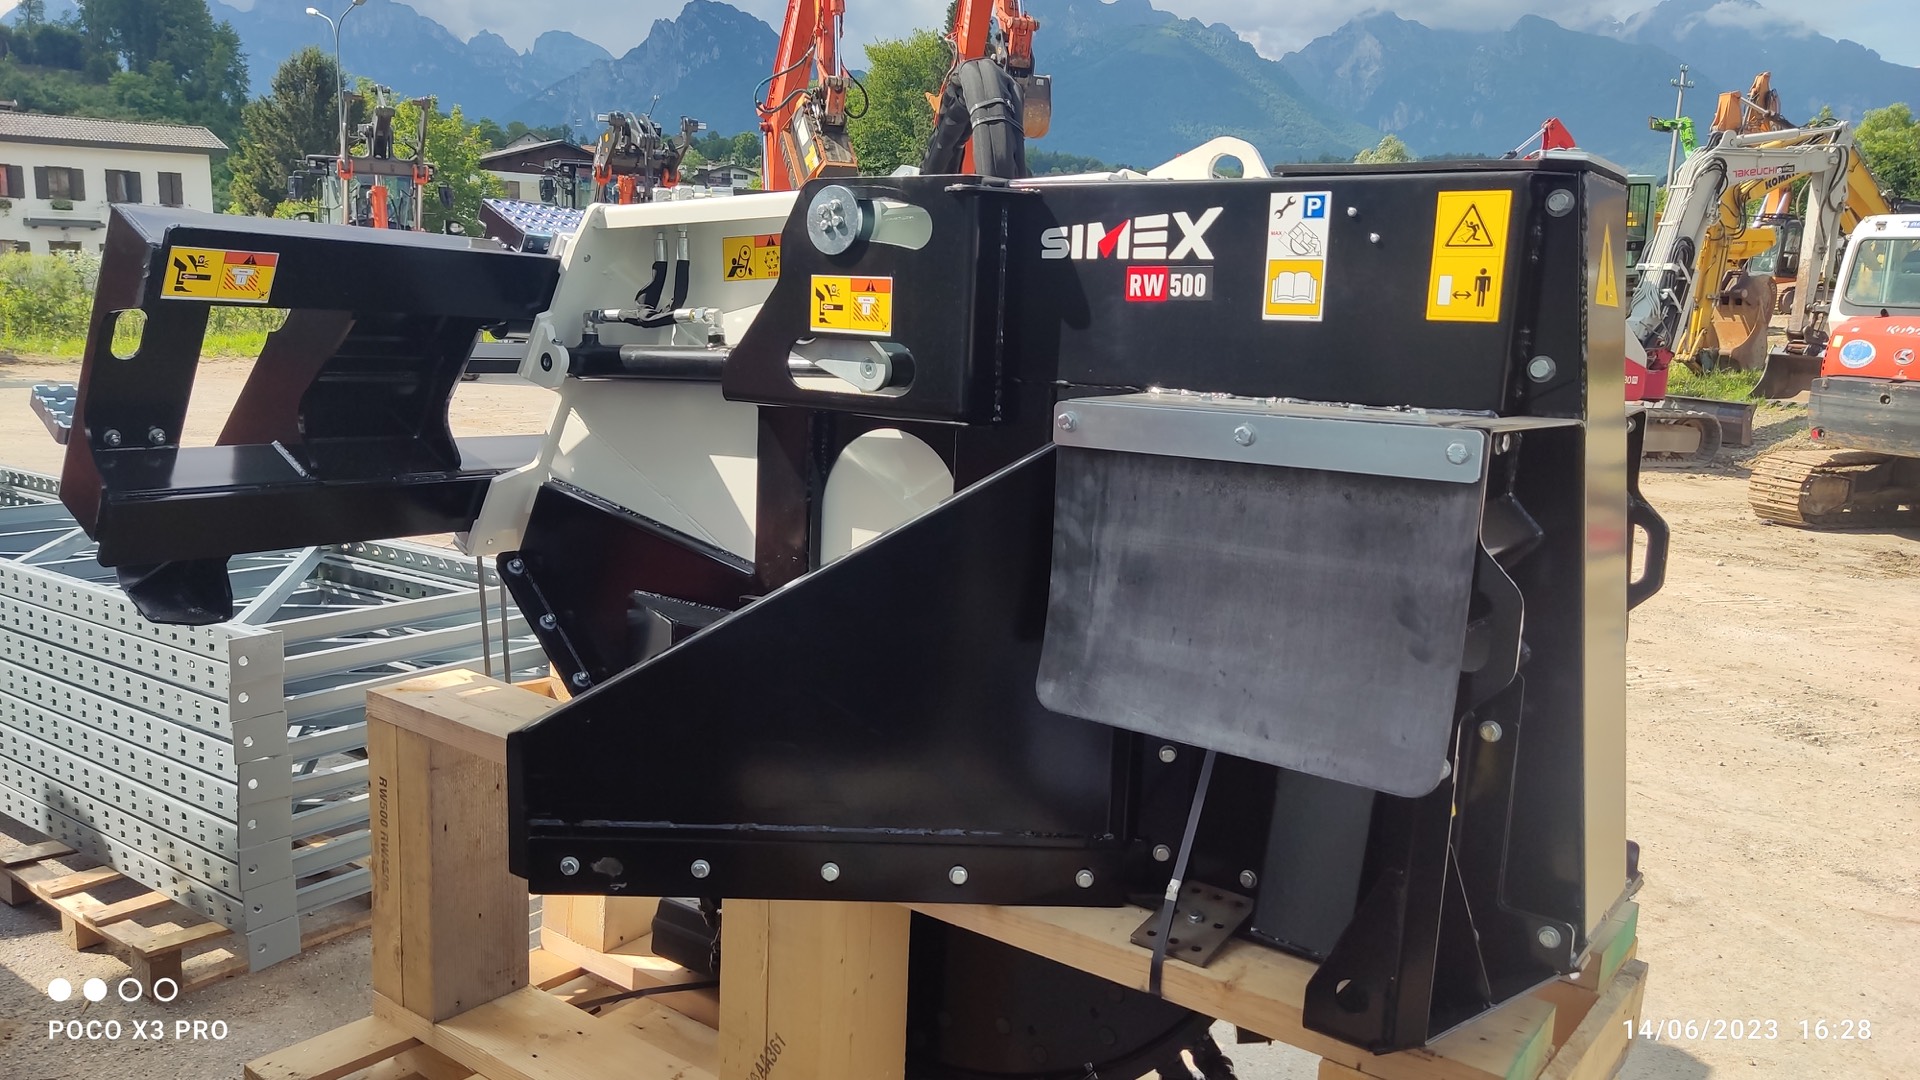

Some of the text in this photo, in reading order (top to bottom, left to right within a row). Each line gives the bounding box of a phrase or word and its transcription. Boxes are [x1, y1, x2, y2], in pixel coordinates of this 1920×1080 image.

[1306, 197, 1322, 217] P
[1041, 206, 1224, 260] SIMEX
[1129, 273, 1207, 297] RW 500
[379, 776, 388, 828] RW500
[745, 1032, 786, 1080] AA361
